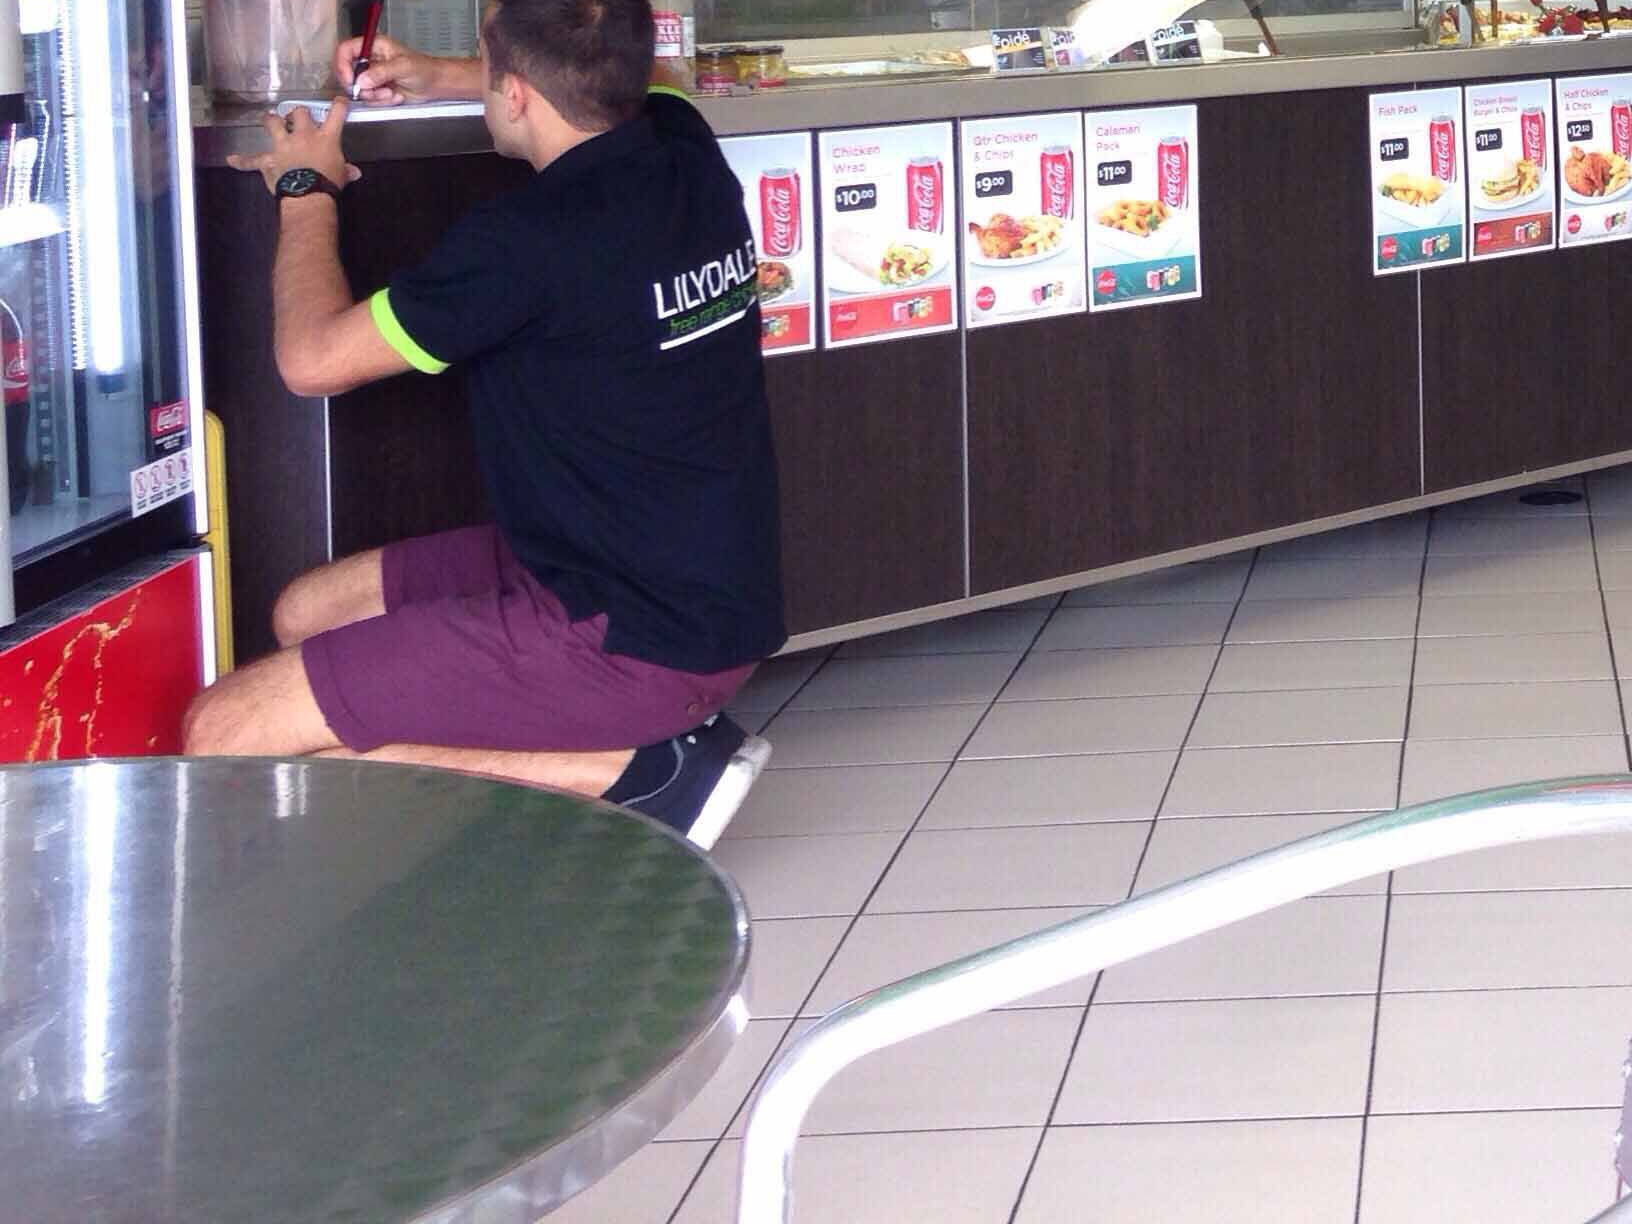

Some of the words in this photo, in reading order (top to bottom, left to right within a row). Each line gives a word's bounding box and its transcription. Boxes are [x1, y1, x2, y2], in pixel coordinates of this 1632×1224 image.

[1563, 90, 1579, 99] Half
[1580, 87, 1609, 98] Chicken
[1377, 105, 1396, 117] Fish
[1398, 104, 1418, 114] Pack
[1572, 101, 1592, 112] Chips
[974, 135, 992, 147] Qtr
[994, 132, 1039, 145] Chicken
[831, 144, 881, 159] Chicken
[984, 149, 1015, 161] Chips
[653, 239, 757, 320] LILYDALE
